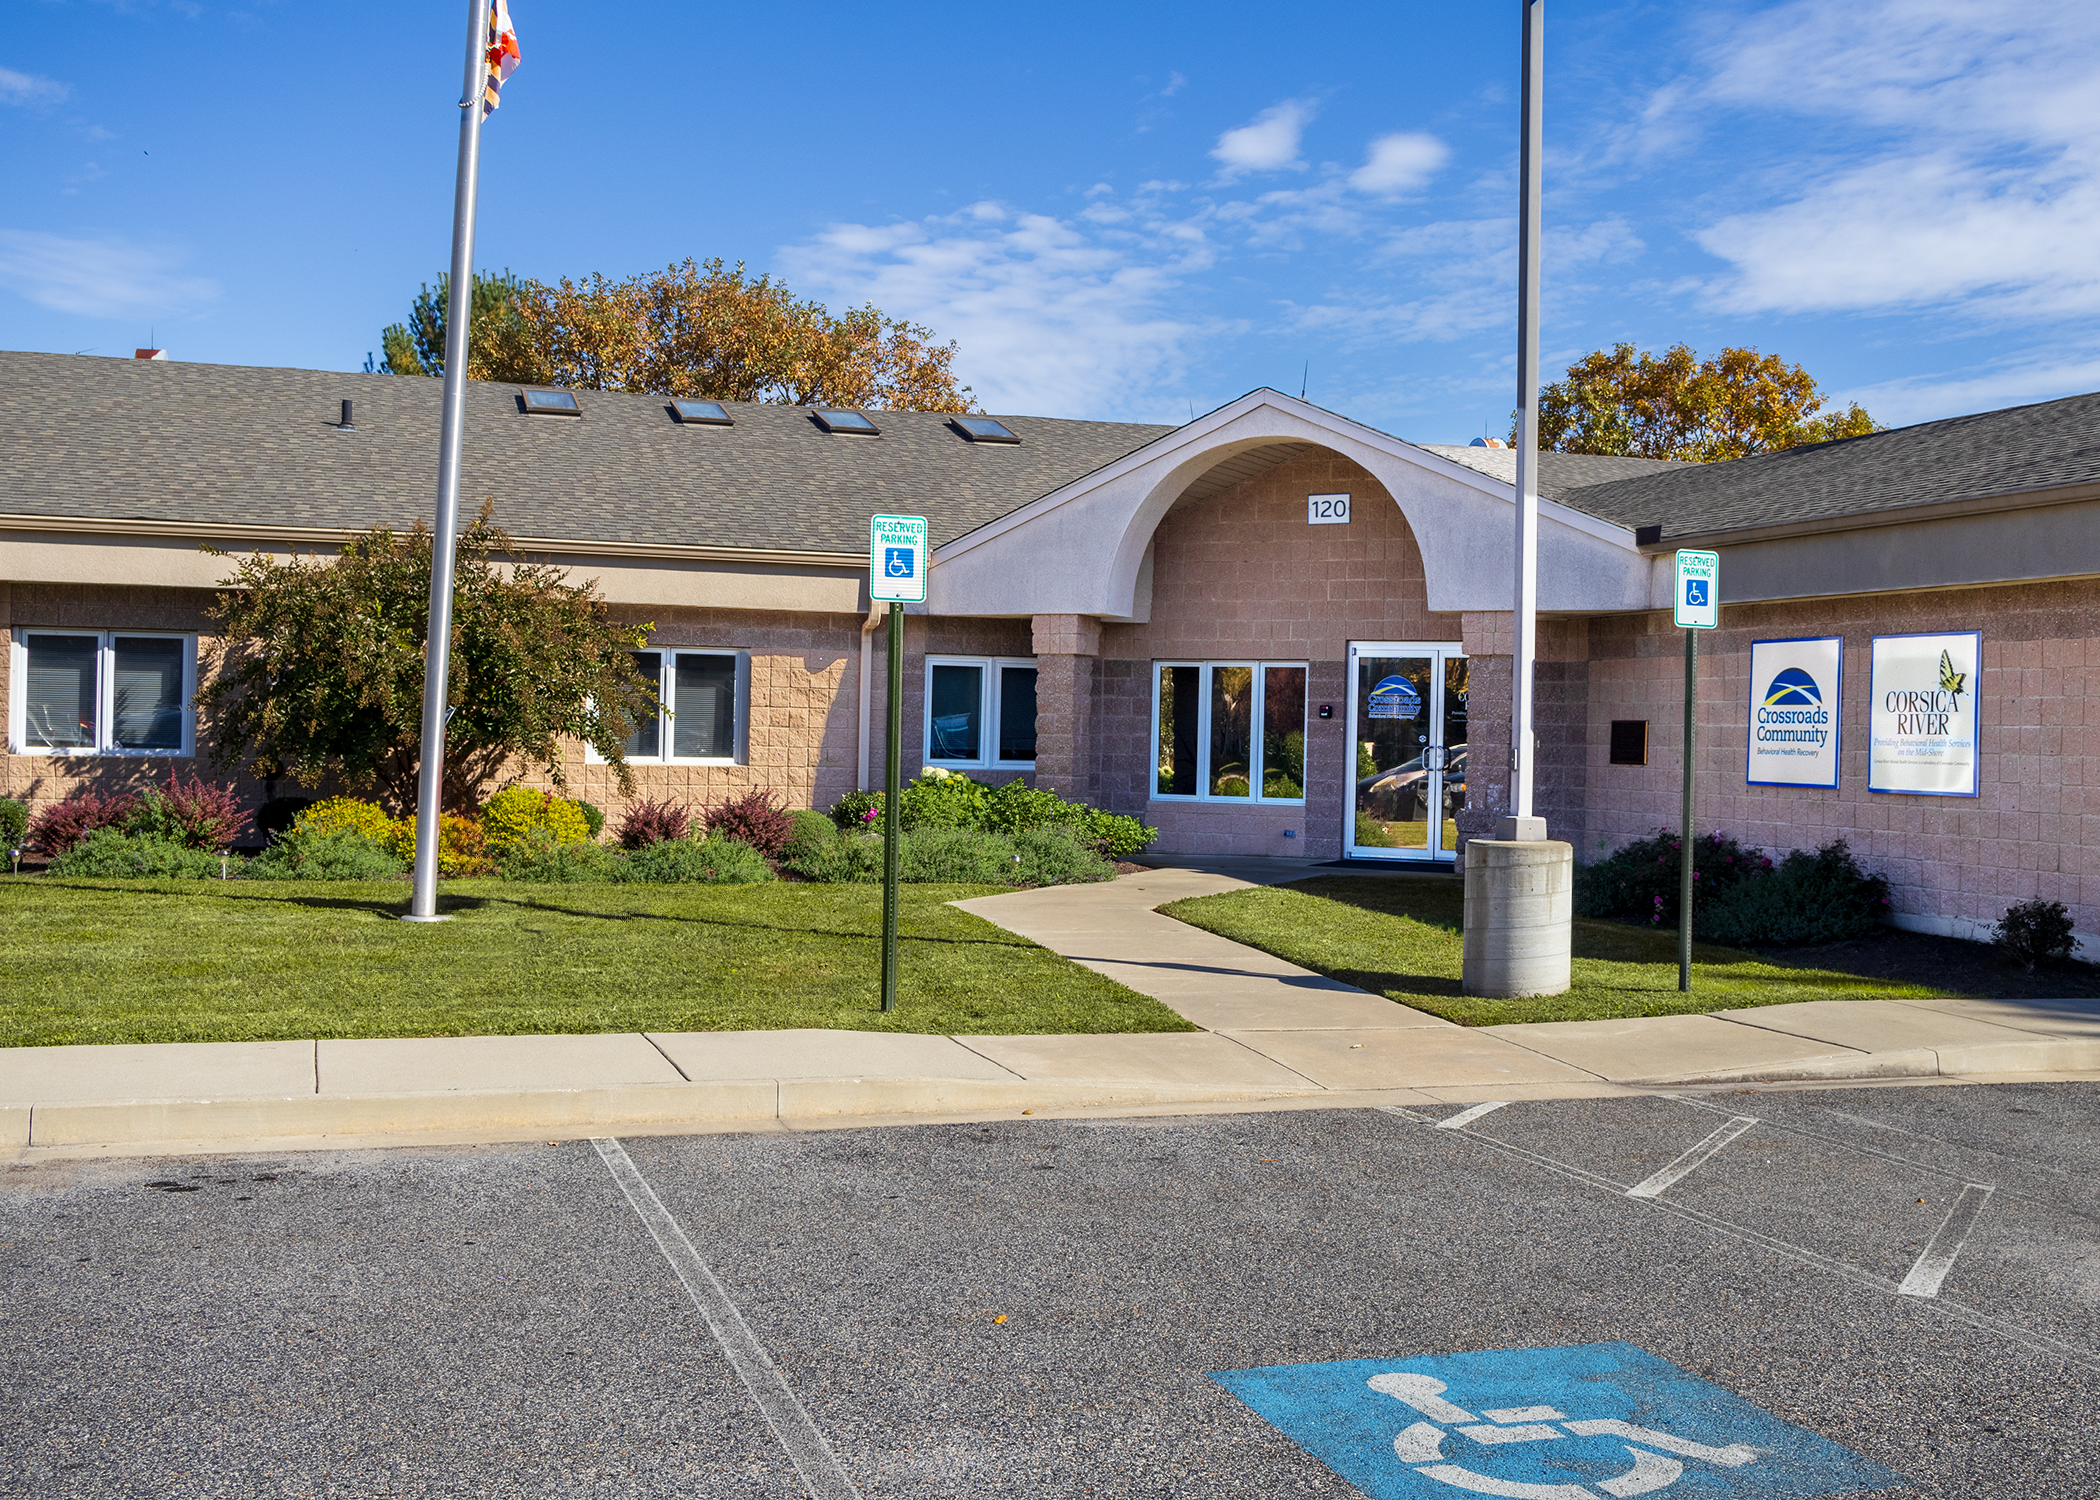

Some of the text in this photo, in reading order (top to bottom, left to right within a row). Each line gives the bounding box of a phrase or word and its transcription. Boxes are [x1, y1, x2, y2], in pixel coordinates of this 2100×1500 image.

[1312, 500, 1346, 518] 120
[876, 521, 923, 534] RESERVED
[880, 533, 918, 546] PARKING
[1680, 555, 1715, 567] RESERVED
[1683, 566, 1711, 578] PARKING
[1367, 694, 1421, 704] Crossroads
[1885, 690, 1959, 713] CORSICA
[1757, 706, 1828, 724] Crossroads
[1897, 713, 1950, 735] RIVER
[1757, 725, 1828, 748] Community
[1948, 739, 1972, 748] Services
[1757, 747, 1819, 758] Behavioral Health Recovery
